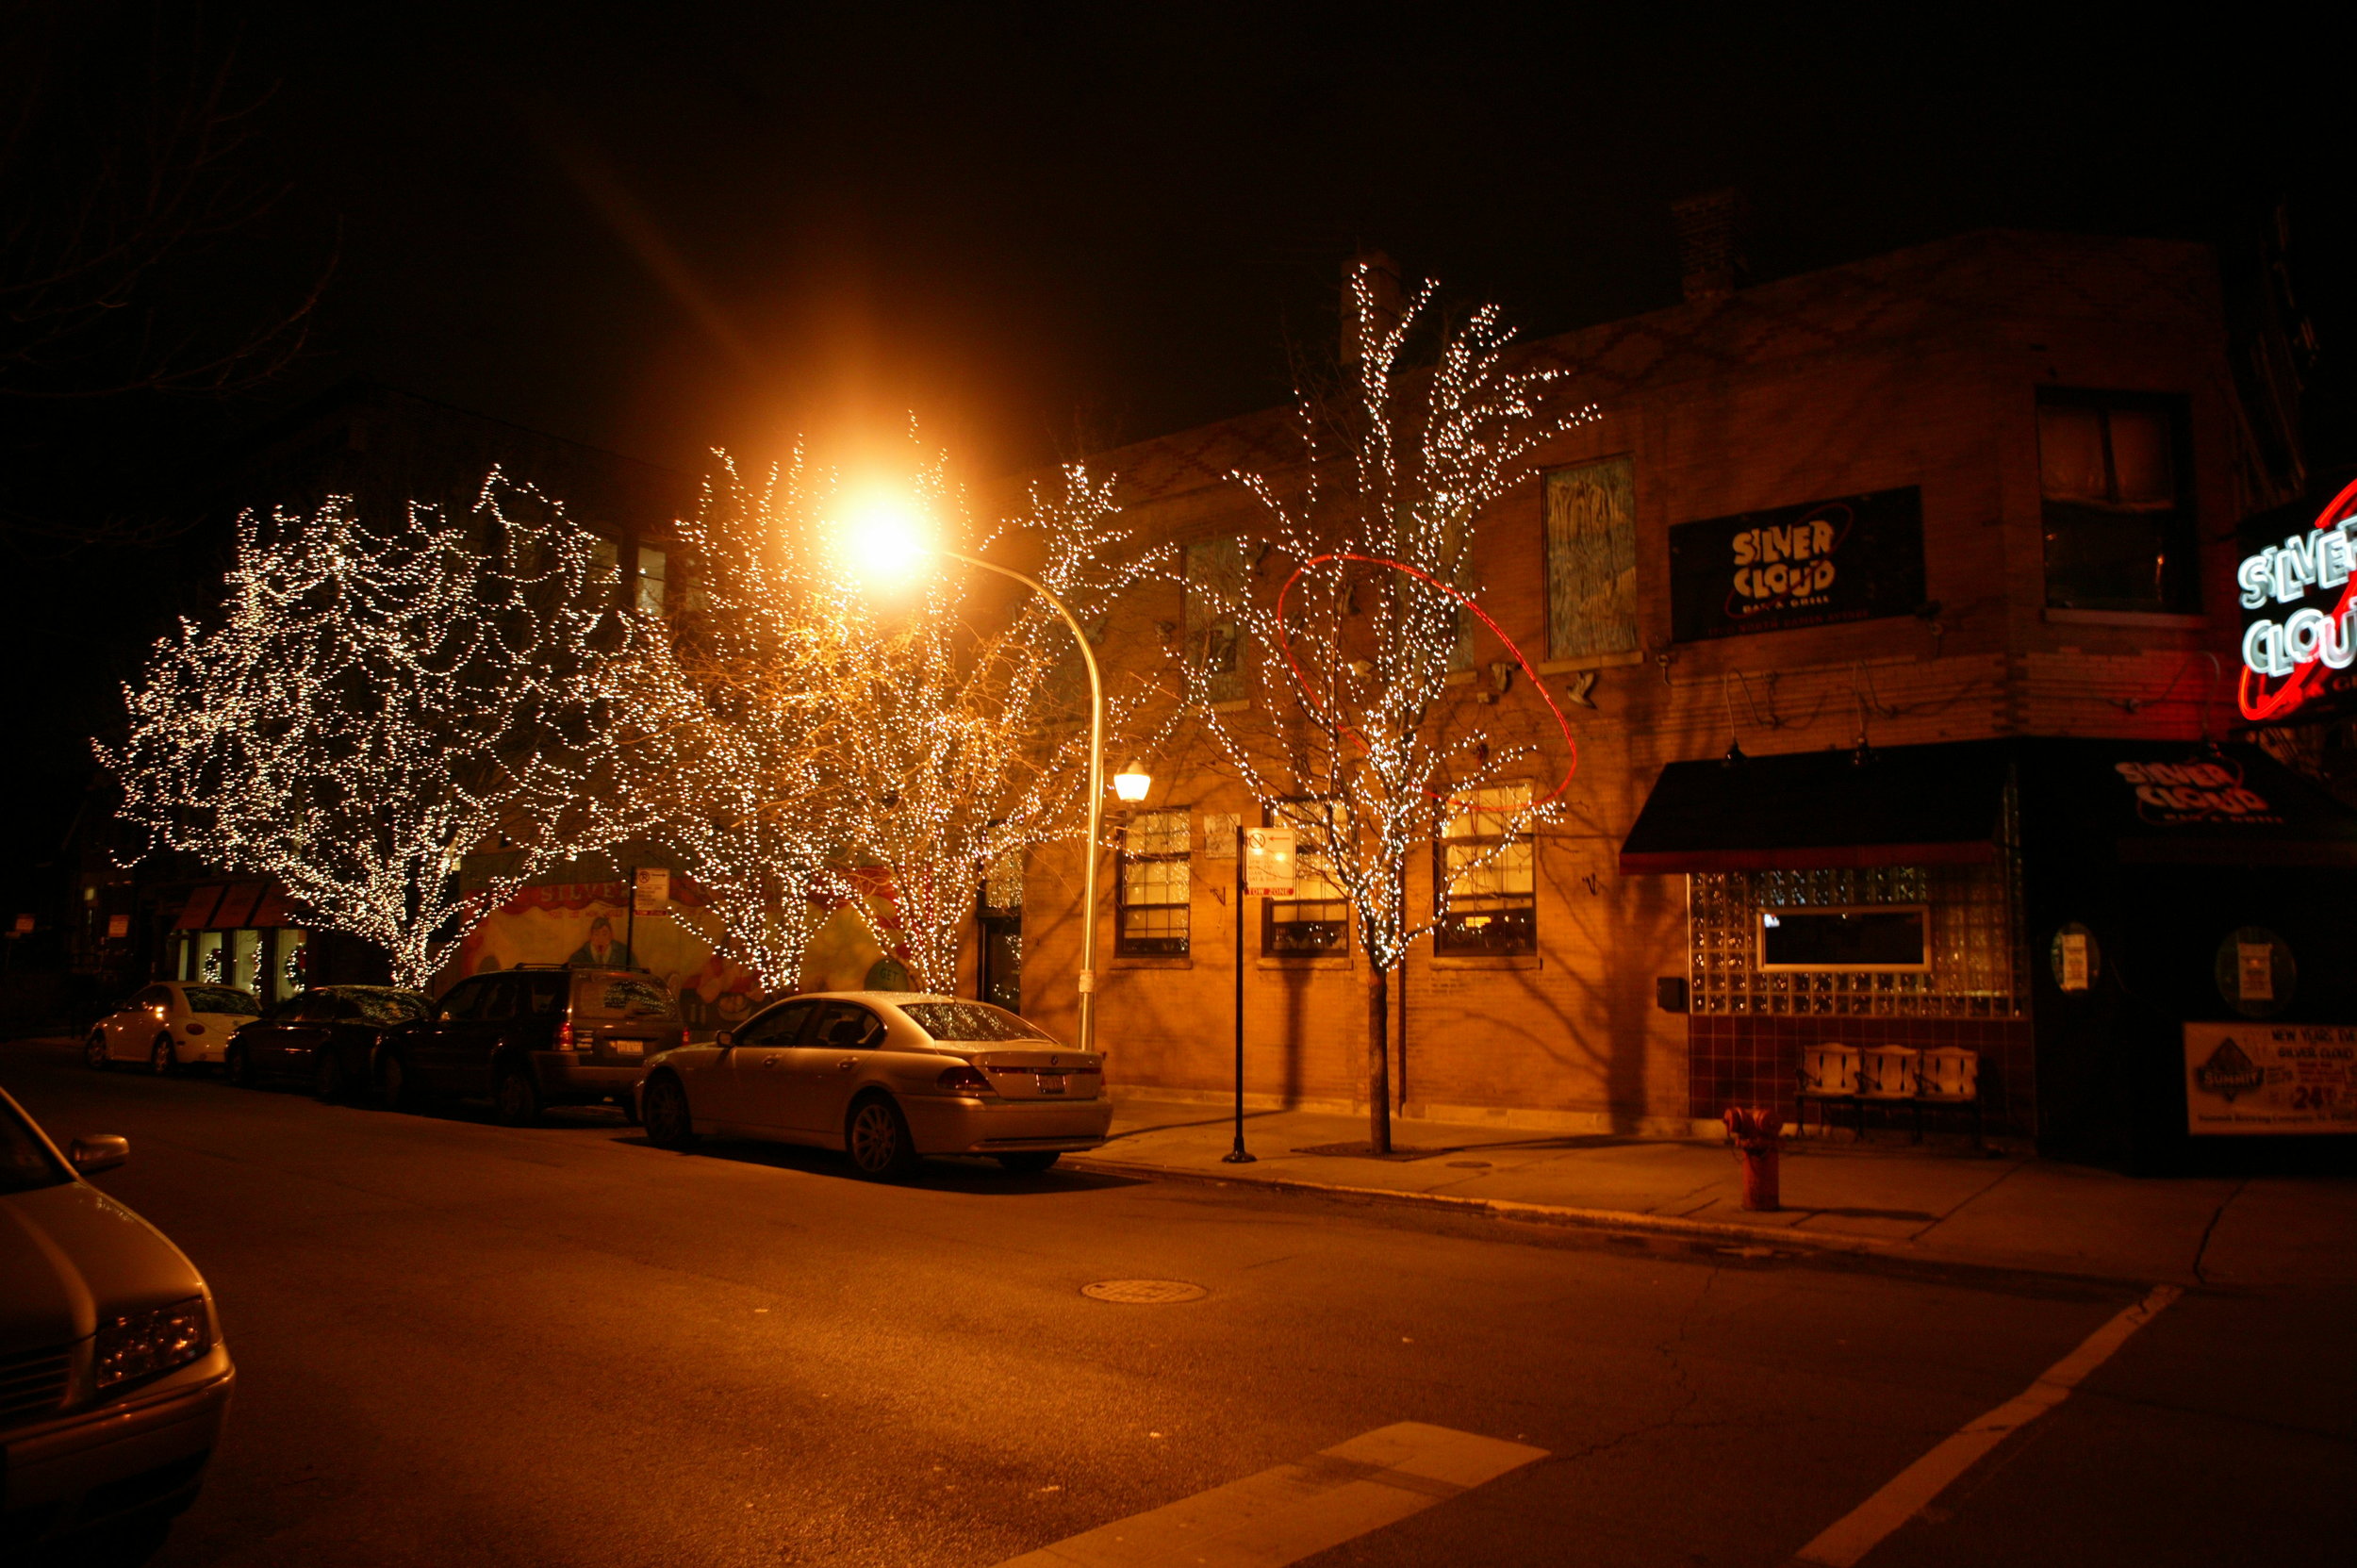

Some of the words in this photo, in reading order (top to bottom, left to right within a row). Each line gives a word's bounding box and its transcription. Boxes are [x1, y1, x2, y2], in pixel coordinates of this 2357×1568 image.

[1732, 520, 1835, 566] SILVER
[1733, 560, 1837, 599] CLOUD
[2242, 596, 2357, 678] CLOU
[2115, 762, 2241, 787] SILVER
[2135, 784, 2270, 814] CLOUD
[2278, 1048, 2316, 1058] SILVER
[2319, 1048, 2353, 1060] CLOUD
